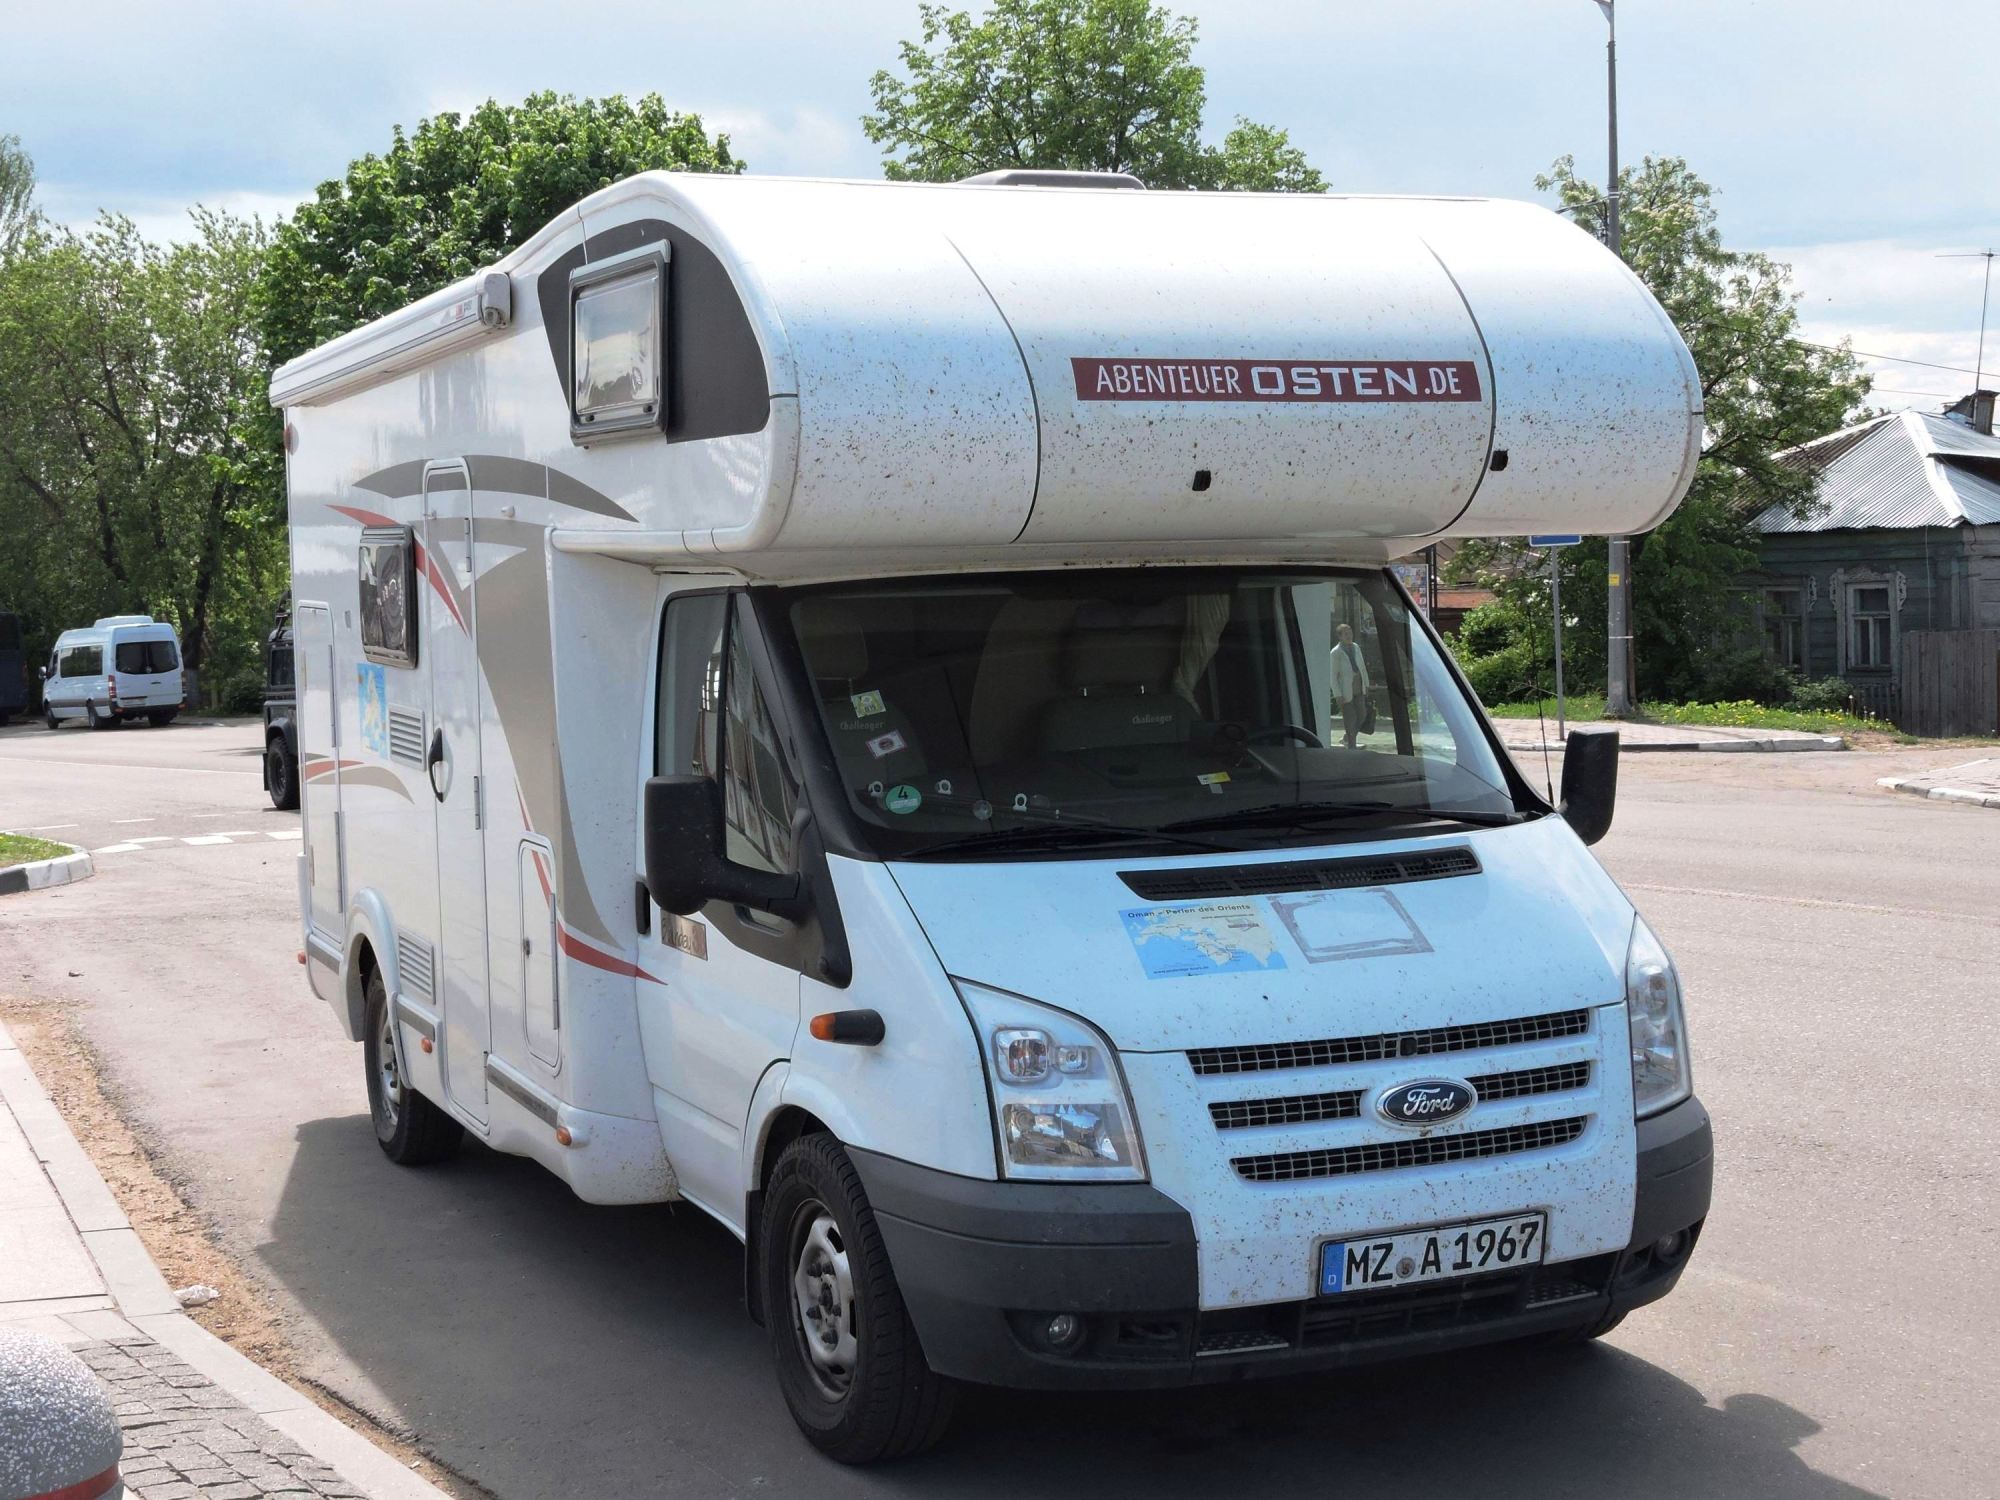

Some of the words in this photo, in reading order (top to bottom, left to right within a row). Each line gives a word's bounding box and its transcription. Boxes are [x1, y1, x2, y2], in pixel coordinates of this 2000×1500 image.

[1096, 364, 1242, 394] ABENTEUER
[1251, 366, 1462, 395] OSTEN.DE
[898, 786, 908, 799] 4
[1403, 1087, 1455, 1116] Ford
[1345, 1242, 1393, 1286] MZ
[1420, 1236, 1441, 1275] A
[1452, 1221, 1539, 1271] 1967
[1327, 1274, 1337, 1286] D
